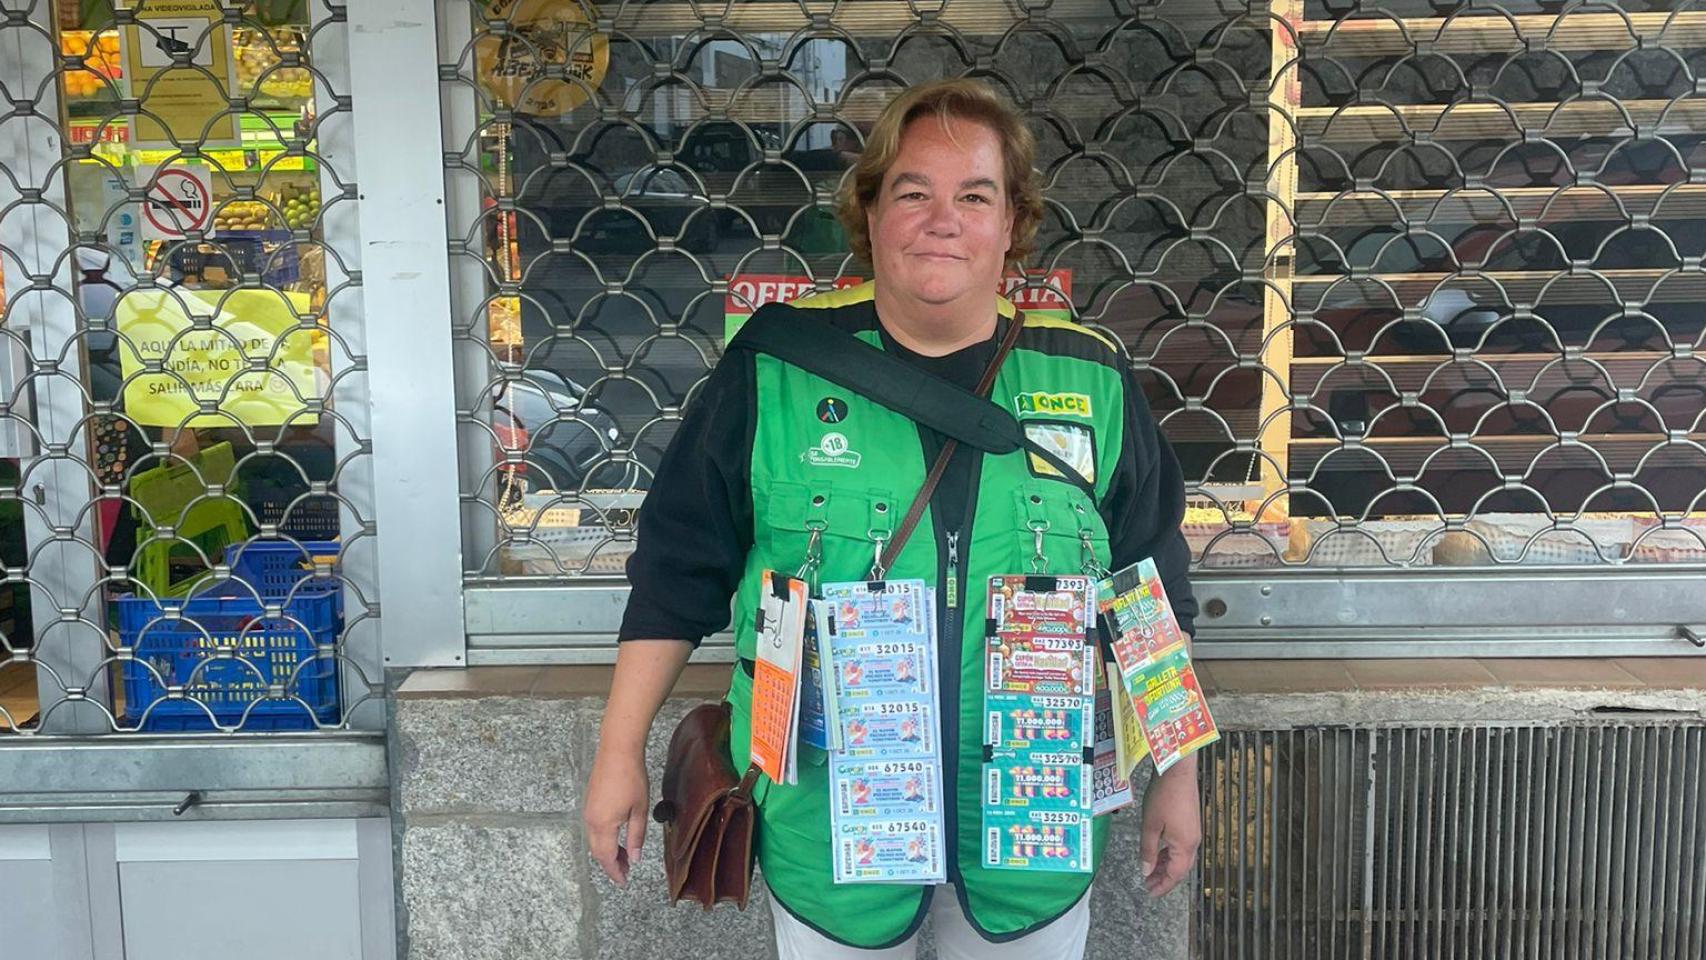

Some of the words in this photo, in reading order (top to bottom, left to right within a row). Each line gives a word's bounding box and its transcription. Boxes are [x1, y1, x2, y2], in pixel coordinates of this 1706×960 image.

[180, 340, 197, 352] LA
[251, 338, 269, 350] DE
[208, 358, 230, 371] NO
[1038, 395, 1086, 412] ONCE
[881, 583, 911, 594] 015
[1056, 579, 1083, 590] 7393
[876, 643, 915, 654] 32015
[1047, 639, 1081, 650] 77393
[880, 702, 919, 714] 32015
[1046, 698, 1080, 708] 32570
[1044, 753, 1078, 764] 32570
[884, 762, 923, 773] 67540
[1043, 812, 1078, 823] 32570
[888, 822, 926, 832] 67540
